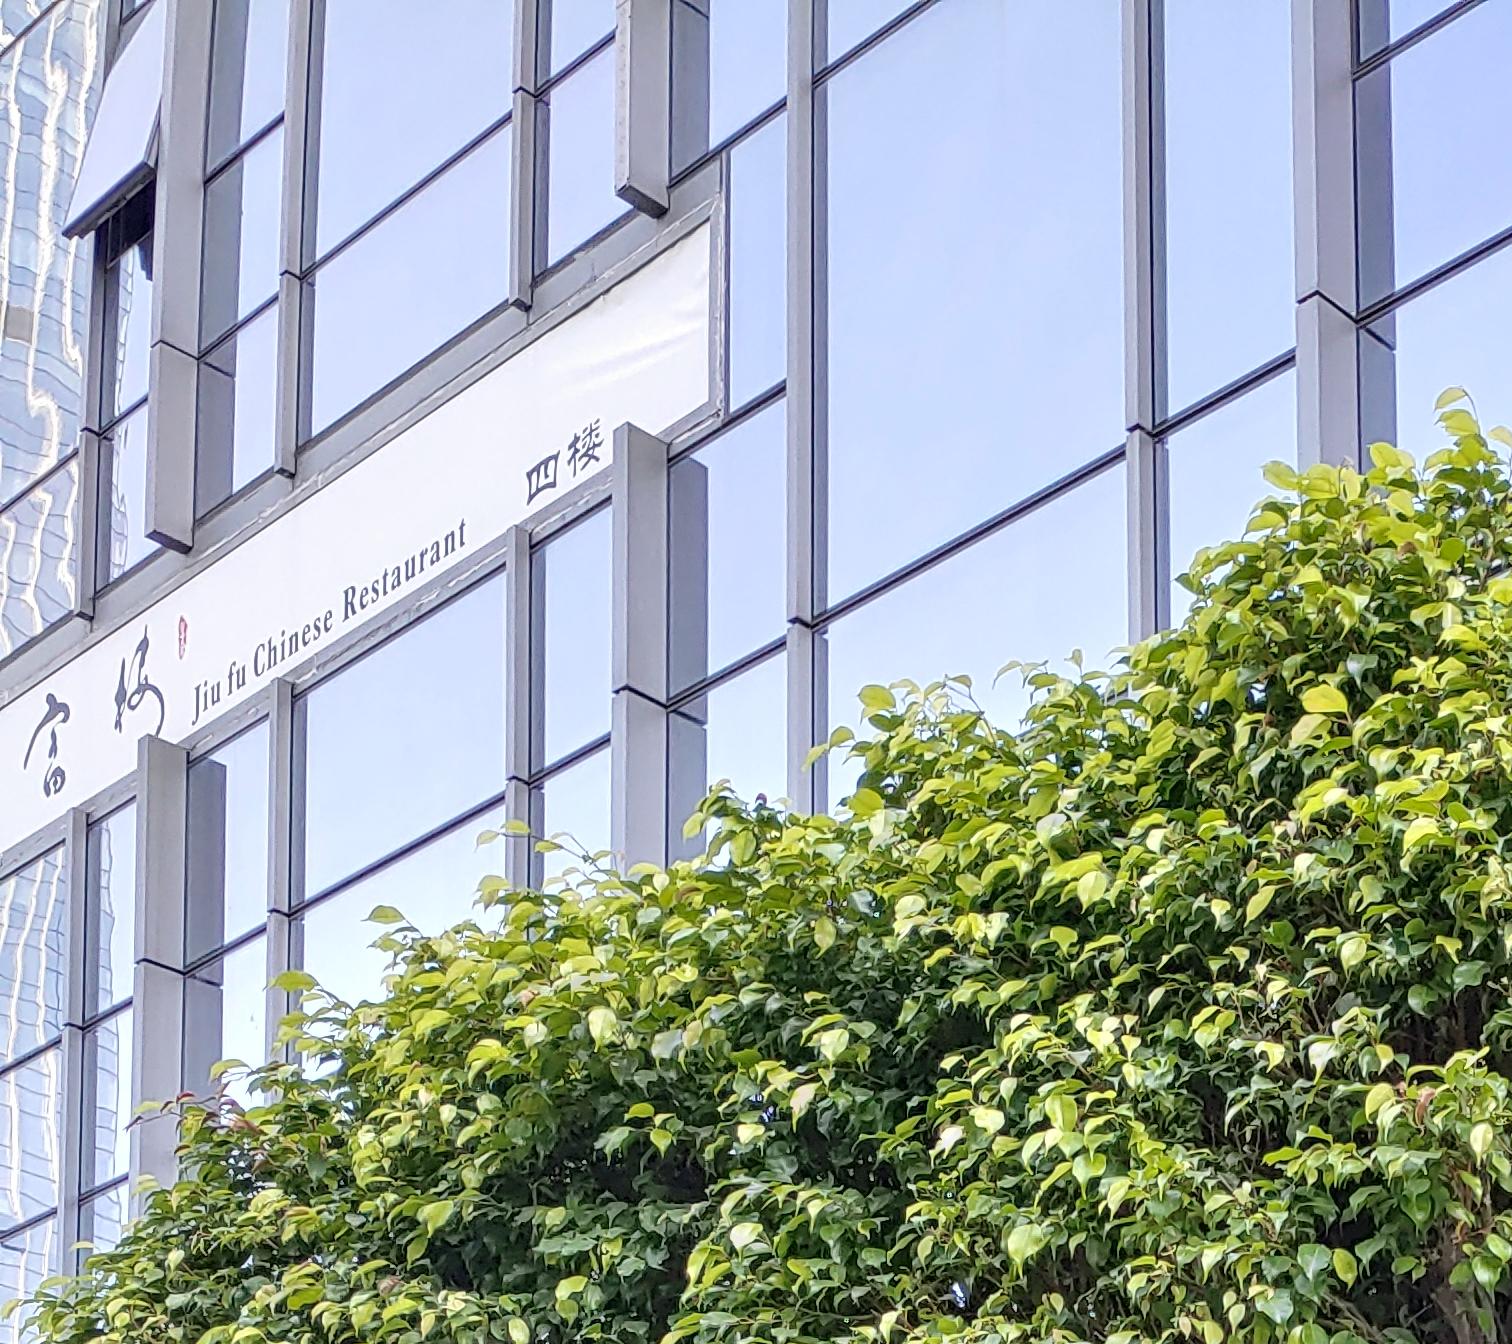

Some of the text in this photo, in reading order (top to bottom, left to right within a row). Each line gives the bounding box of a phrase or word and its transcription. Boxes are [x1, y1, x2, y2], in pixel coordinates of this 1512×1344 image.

[526, 418, 604, 506] 四楼
[191, 679, 221, 727] Jiu
[227, 660, 247, 697] fu
[253, 608, 334, 678] Chinese
[341, 517, 467, 623] Restaurant
